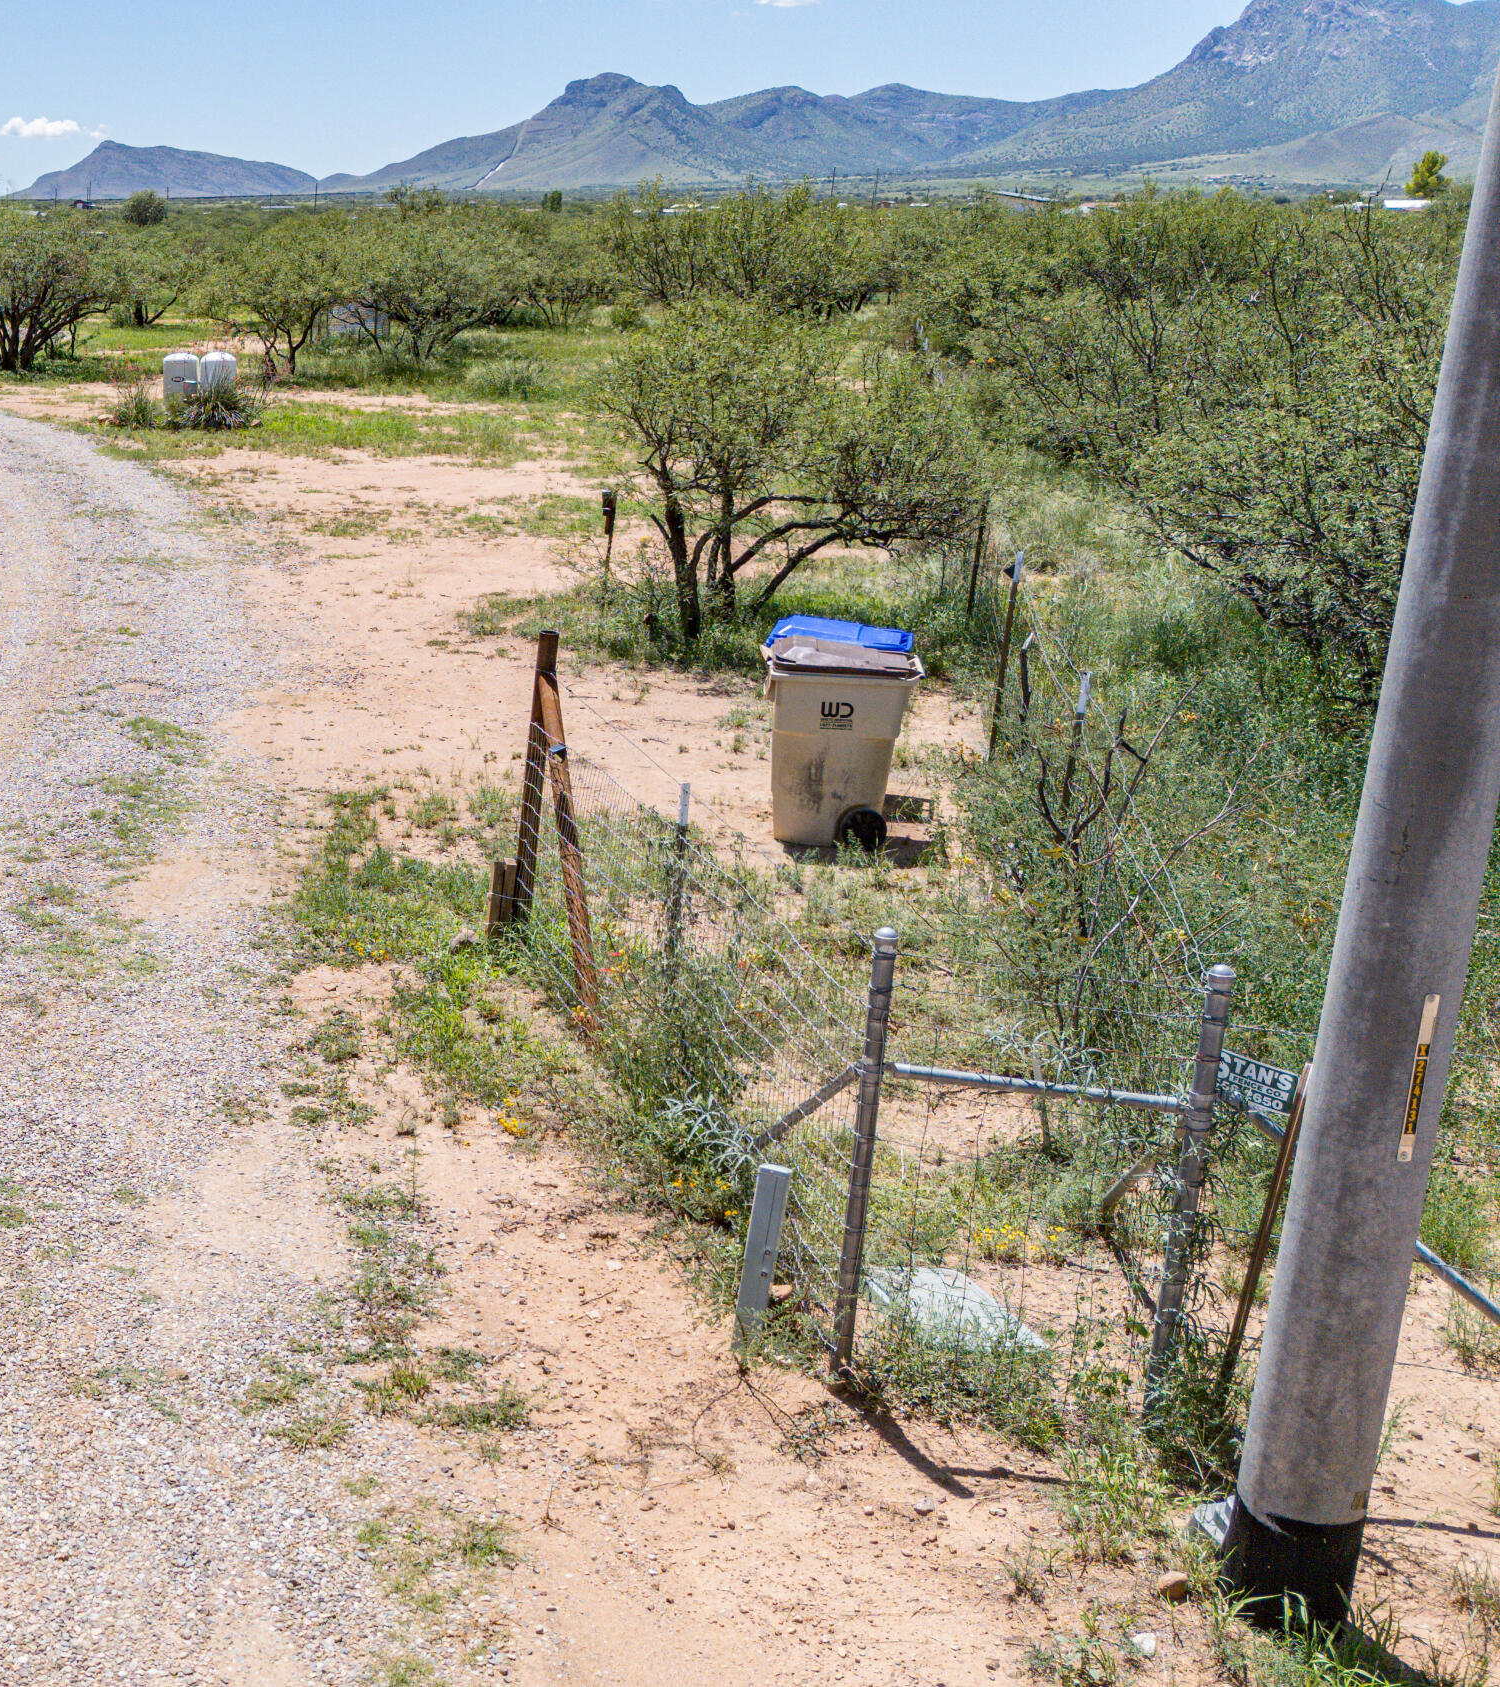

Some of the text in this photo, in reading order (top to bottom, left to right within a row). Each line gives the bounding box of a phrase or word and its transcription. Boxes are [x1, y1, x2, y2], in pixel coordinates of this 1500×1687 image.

[939, 814, 1010, 863] 11488
[1217, 1051, 1294, 1091] STAN'S
[1232, 1074, 1264, 1092] FENCE
[1406, 1060, 1425, 1134] 274131
